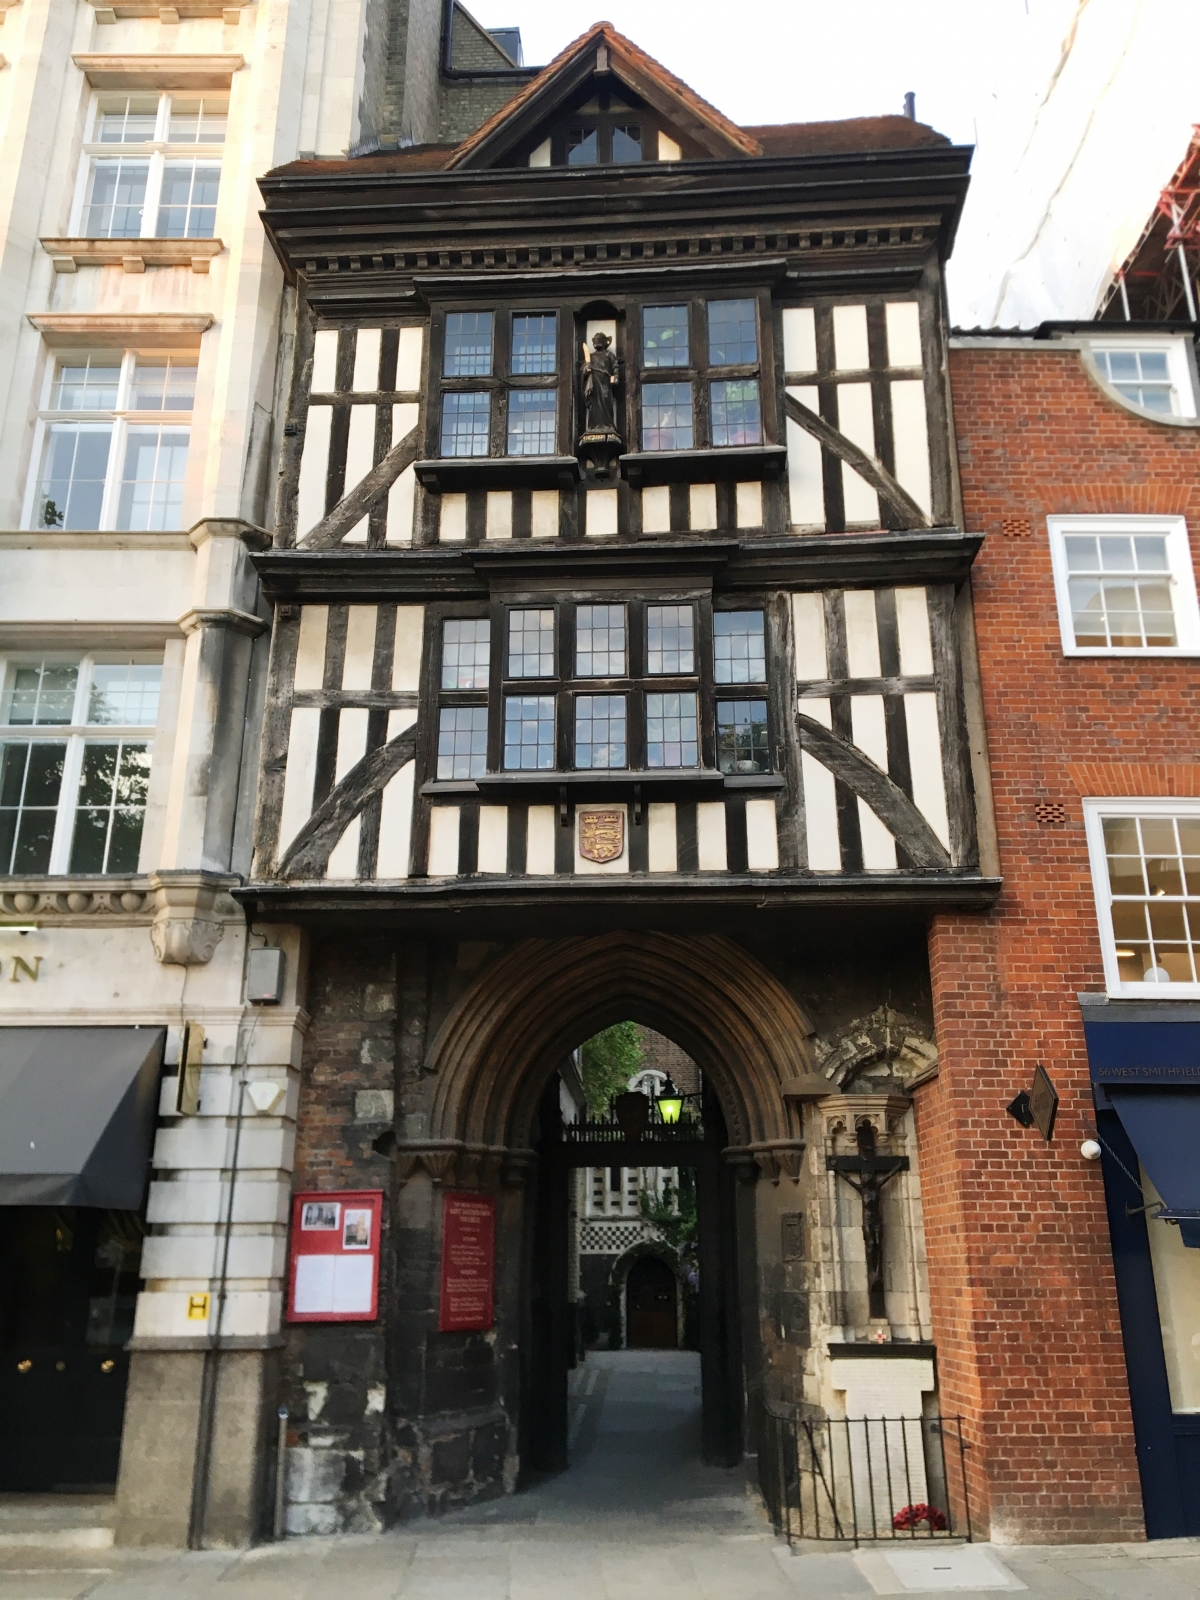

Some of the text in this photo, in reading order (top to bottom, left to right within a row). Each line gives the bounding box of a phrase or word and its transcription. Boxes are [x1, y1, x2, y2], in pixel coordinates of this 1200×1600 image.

[0, 956, 44, 983] N
[1111, 1067, 1140, 1077] WEST
[188, 1296, 207, 1317] H
